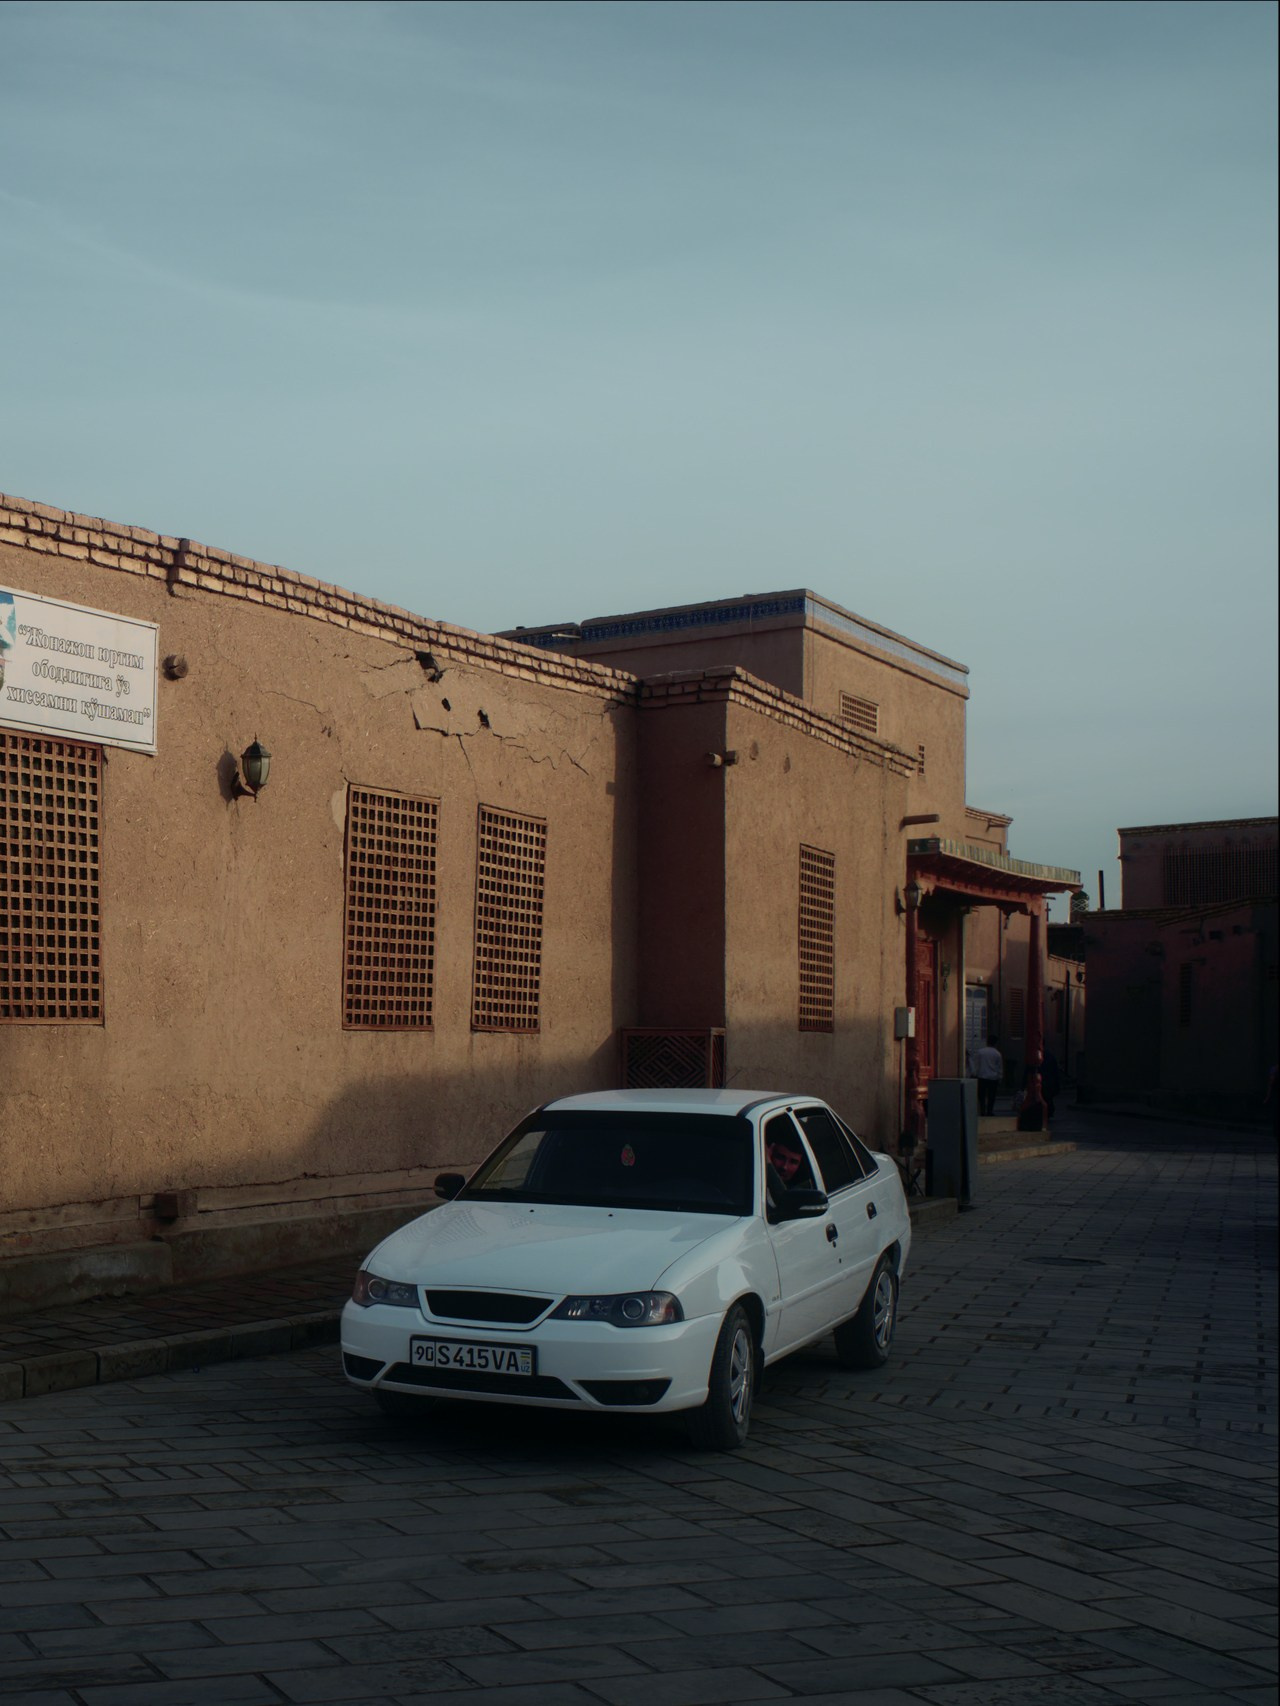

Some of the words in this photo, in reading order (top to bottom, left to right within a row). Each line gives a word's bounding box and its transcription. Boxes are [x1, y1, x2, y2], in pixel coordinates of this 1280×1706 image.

[98, 645, 144, 670] юртим
[32, 659, 112, 692] ободлигига
[115, 674, 131, 698] ўз
[6, 686, 78, 714] хиссамни
[416, 1346, 434, 1362] 90
